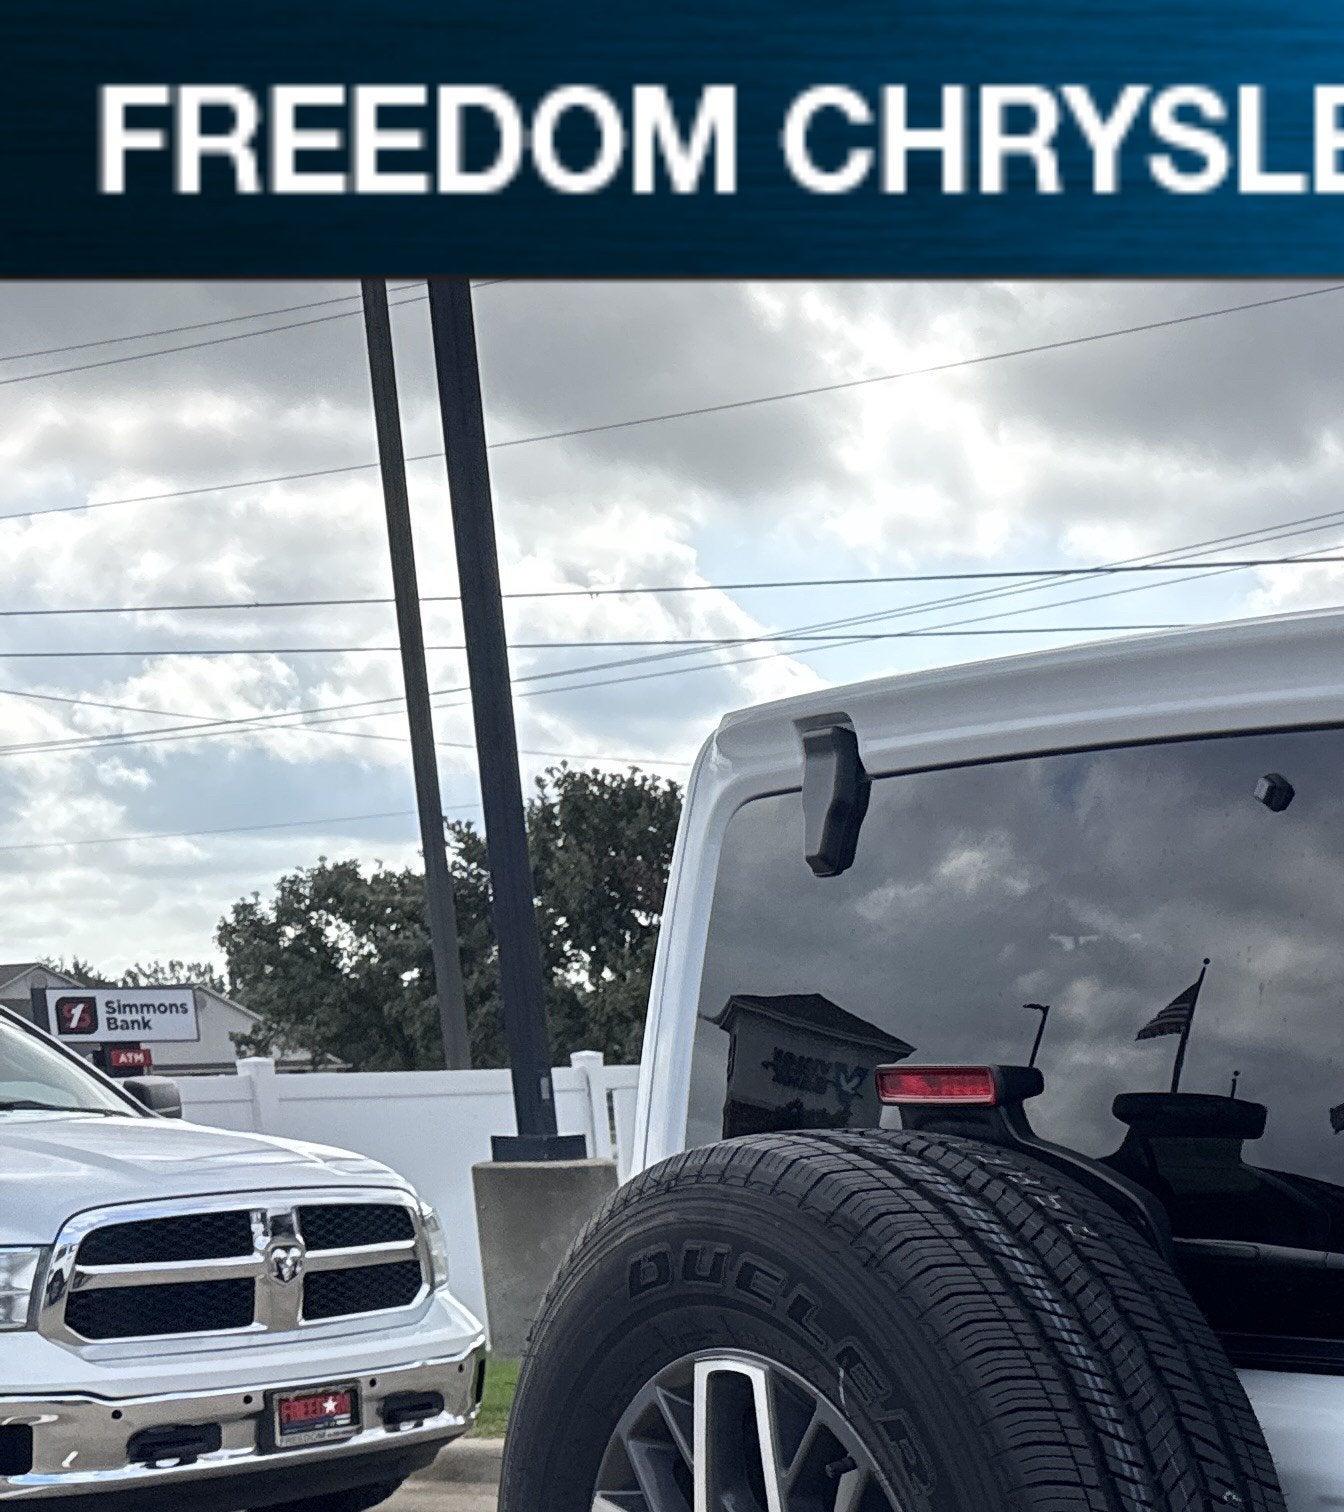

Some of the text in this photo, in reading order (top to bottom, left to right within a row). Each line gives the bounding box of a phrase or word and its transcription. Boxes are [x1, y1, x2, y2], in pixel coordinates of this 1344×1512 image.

[105, 999, 189, 1015] Simmons
[106, 1015, 153, 1031] Bank
[118, 1052, 145, 1064] ATM
[625, 1237, 938, 1498] DUELER
